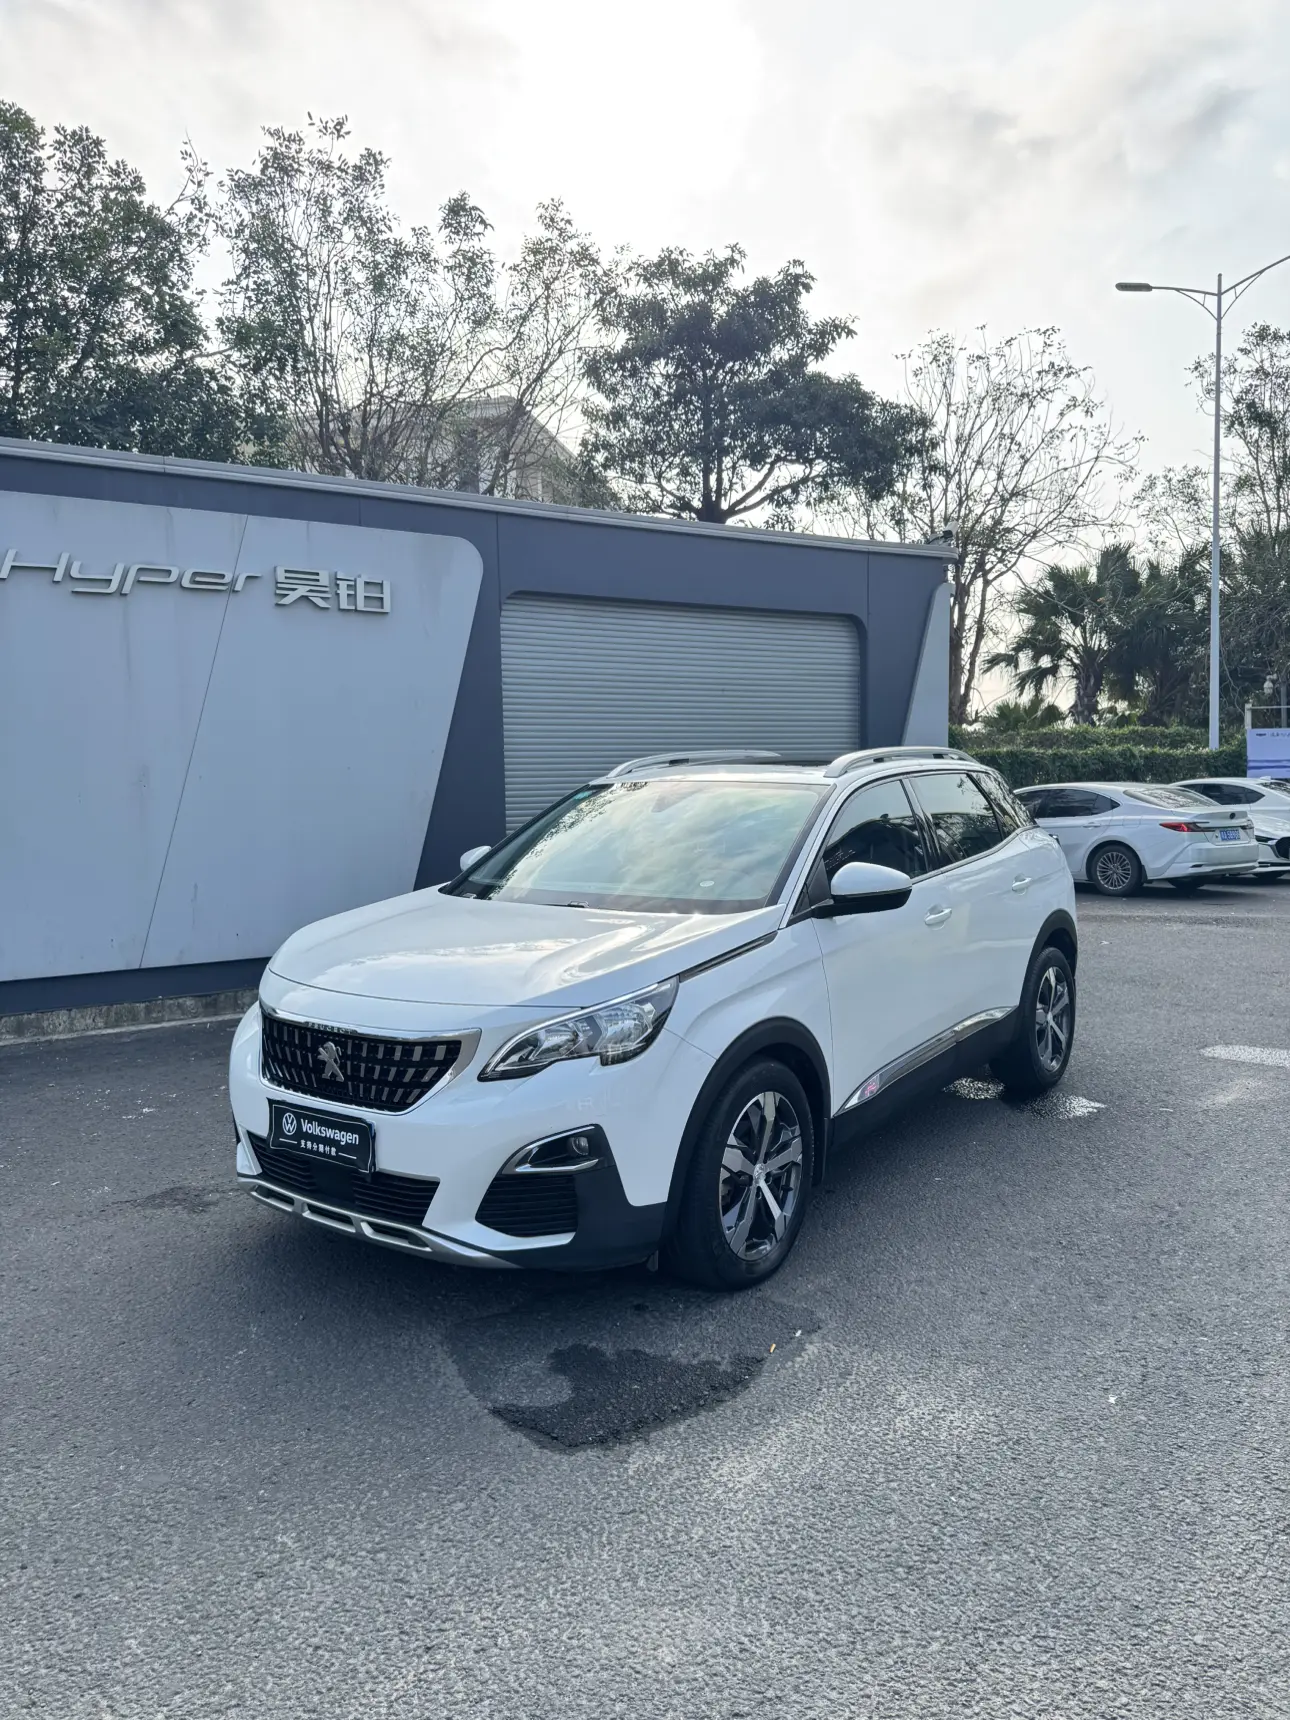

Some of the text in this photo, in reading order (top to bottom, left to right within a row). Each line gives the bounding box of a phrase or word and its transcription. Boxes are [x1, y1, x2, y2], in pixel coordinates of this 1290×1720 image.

[0, 548, 392, 614] Hyper 昊铂
[301, 1118, 359, 1146] Volkswagen
[300, 1139, 337, 1157] 支持分期付款
